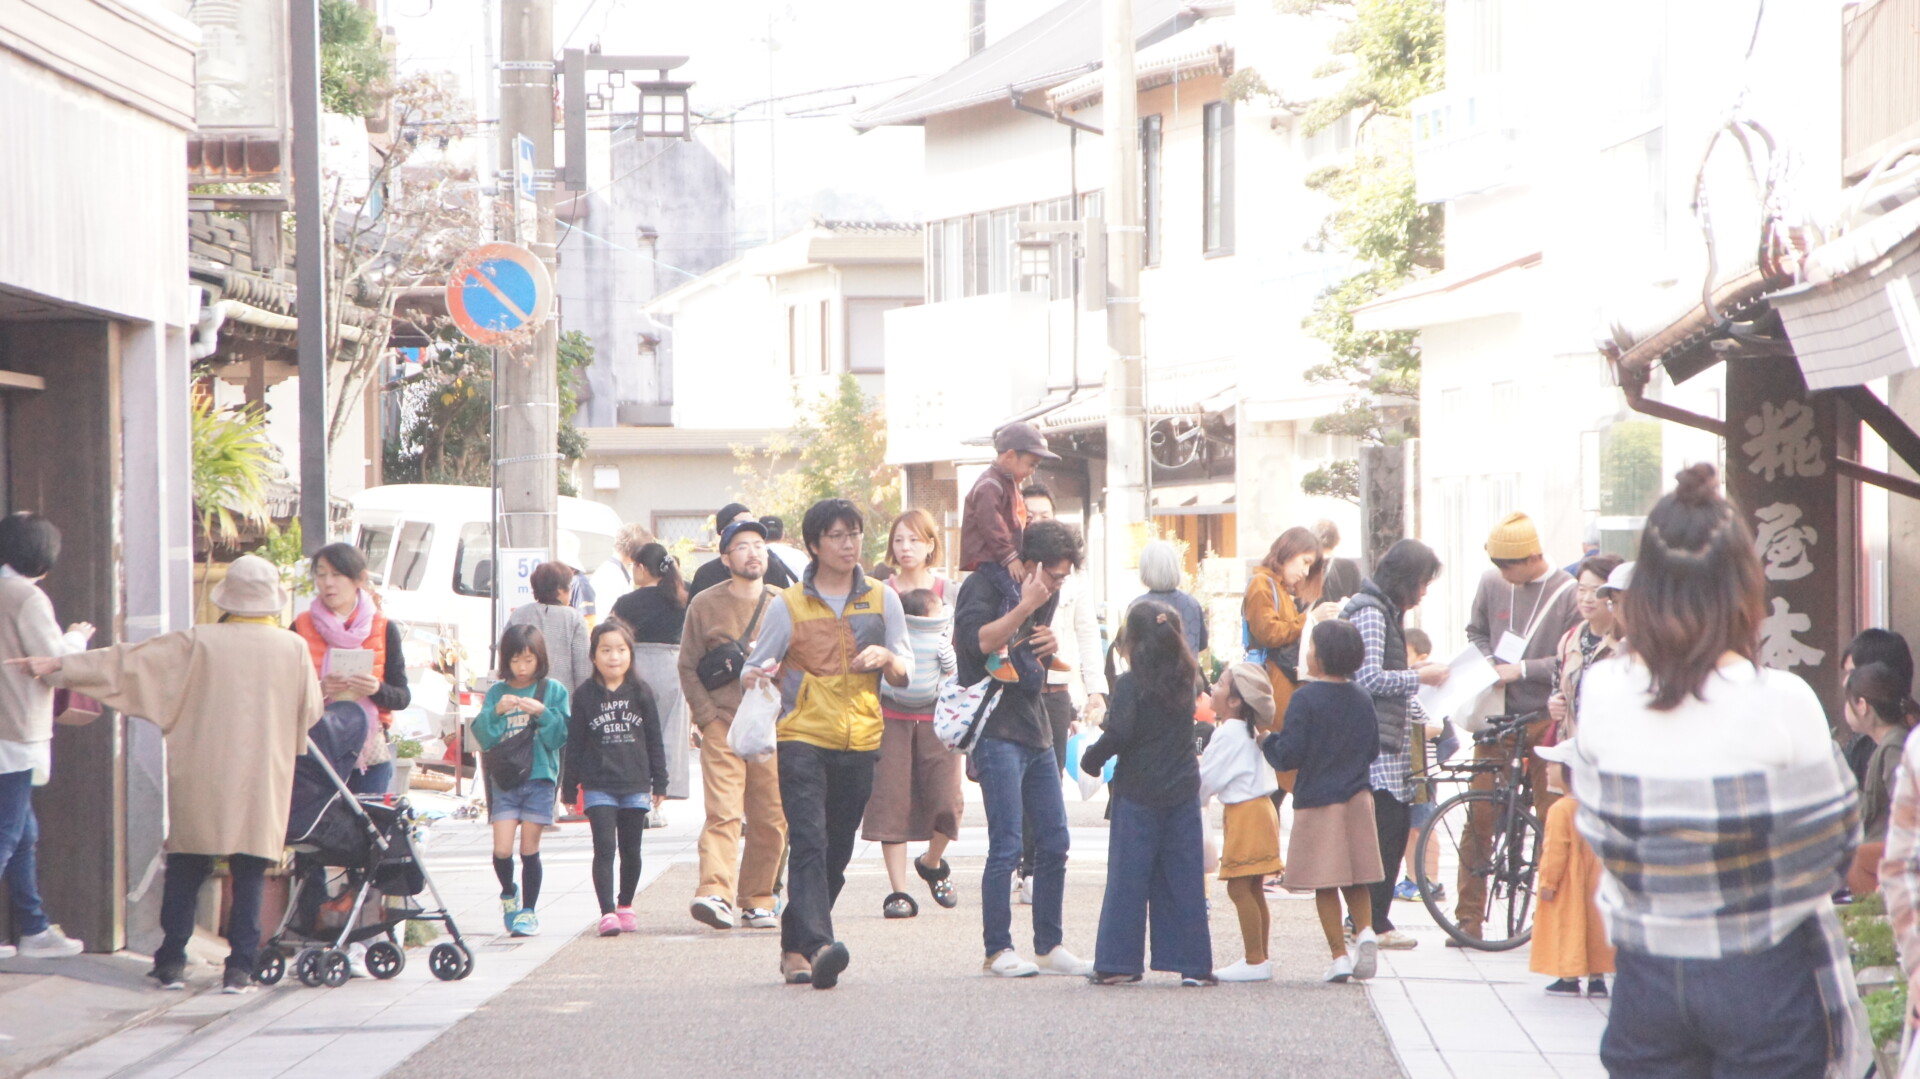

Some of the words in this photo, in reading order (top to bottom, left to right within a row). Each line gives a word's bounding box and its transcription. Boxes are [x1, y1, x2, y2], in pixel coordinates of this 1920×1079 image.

[601, 700, 630, 712] HAPPY
[589, 711, 617, 730] JENNI
[621, 710, 643, 727] LOVE
[603, 723, 631, 733] GIRLY
